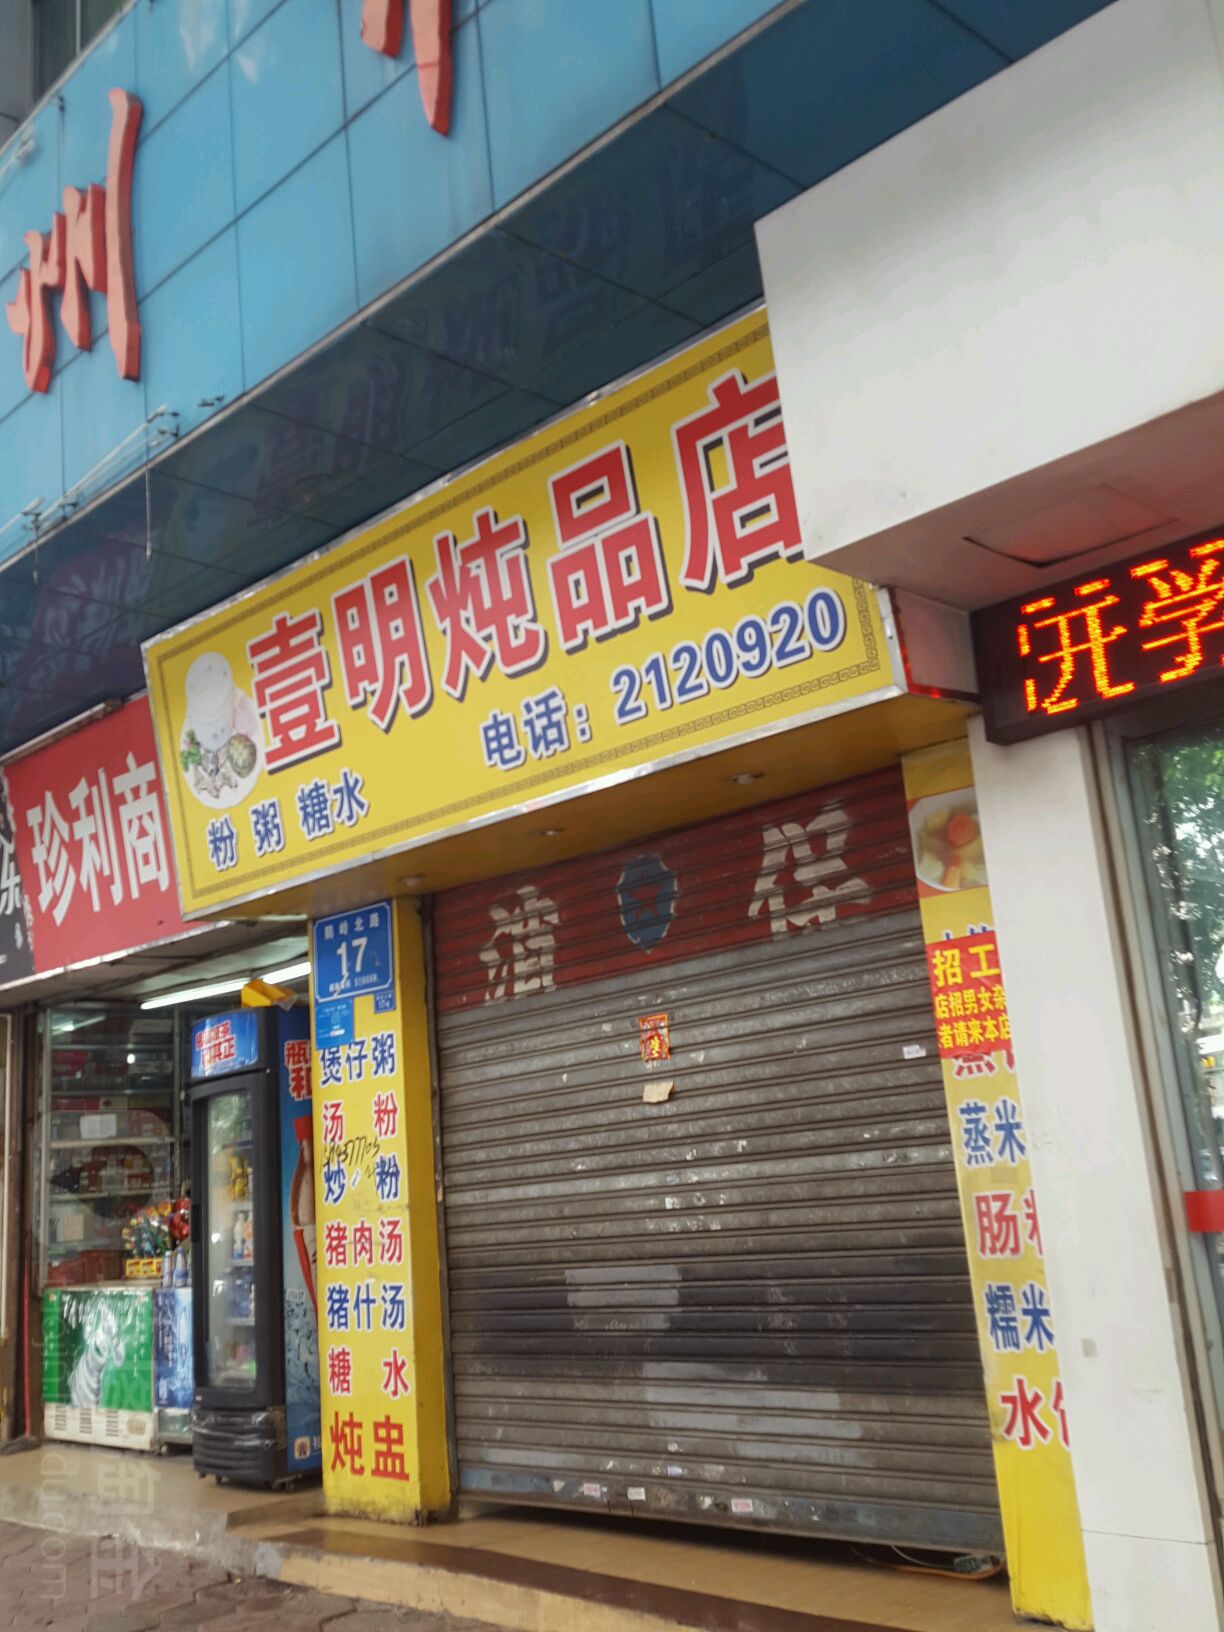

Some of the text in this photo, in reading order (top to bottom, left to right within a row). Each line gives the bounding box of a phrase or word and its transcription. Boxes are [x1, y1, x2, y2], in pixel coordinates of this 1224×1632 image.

[247, 369, 803, 773] 壹明炖品店
[298, 768, 369, 840] 糖水
[26, 753, 170, 926] 珍利商
[336, 937, 368, 977] 17
[933, 943, 1001, 987] 招工
[320, 1033, 396, 1086] 煲仔粥
[326, 1219, 402, 1265] 猪肉汤
[327, 1283, 405, 1330] 猪什汤
[985, 1283, 1055, 1351] 糯米
[330, 1411, 410, 1481] 炖盅
[1001, 1377, 1070, 1447] 水
